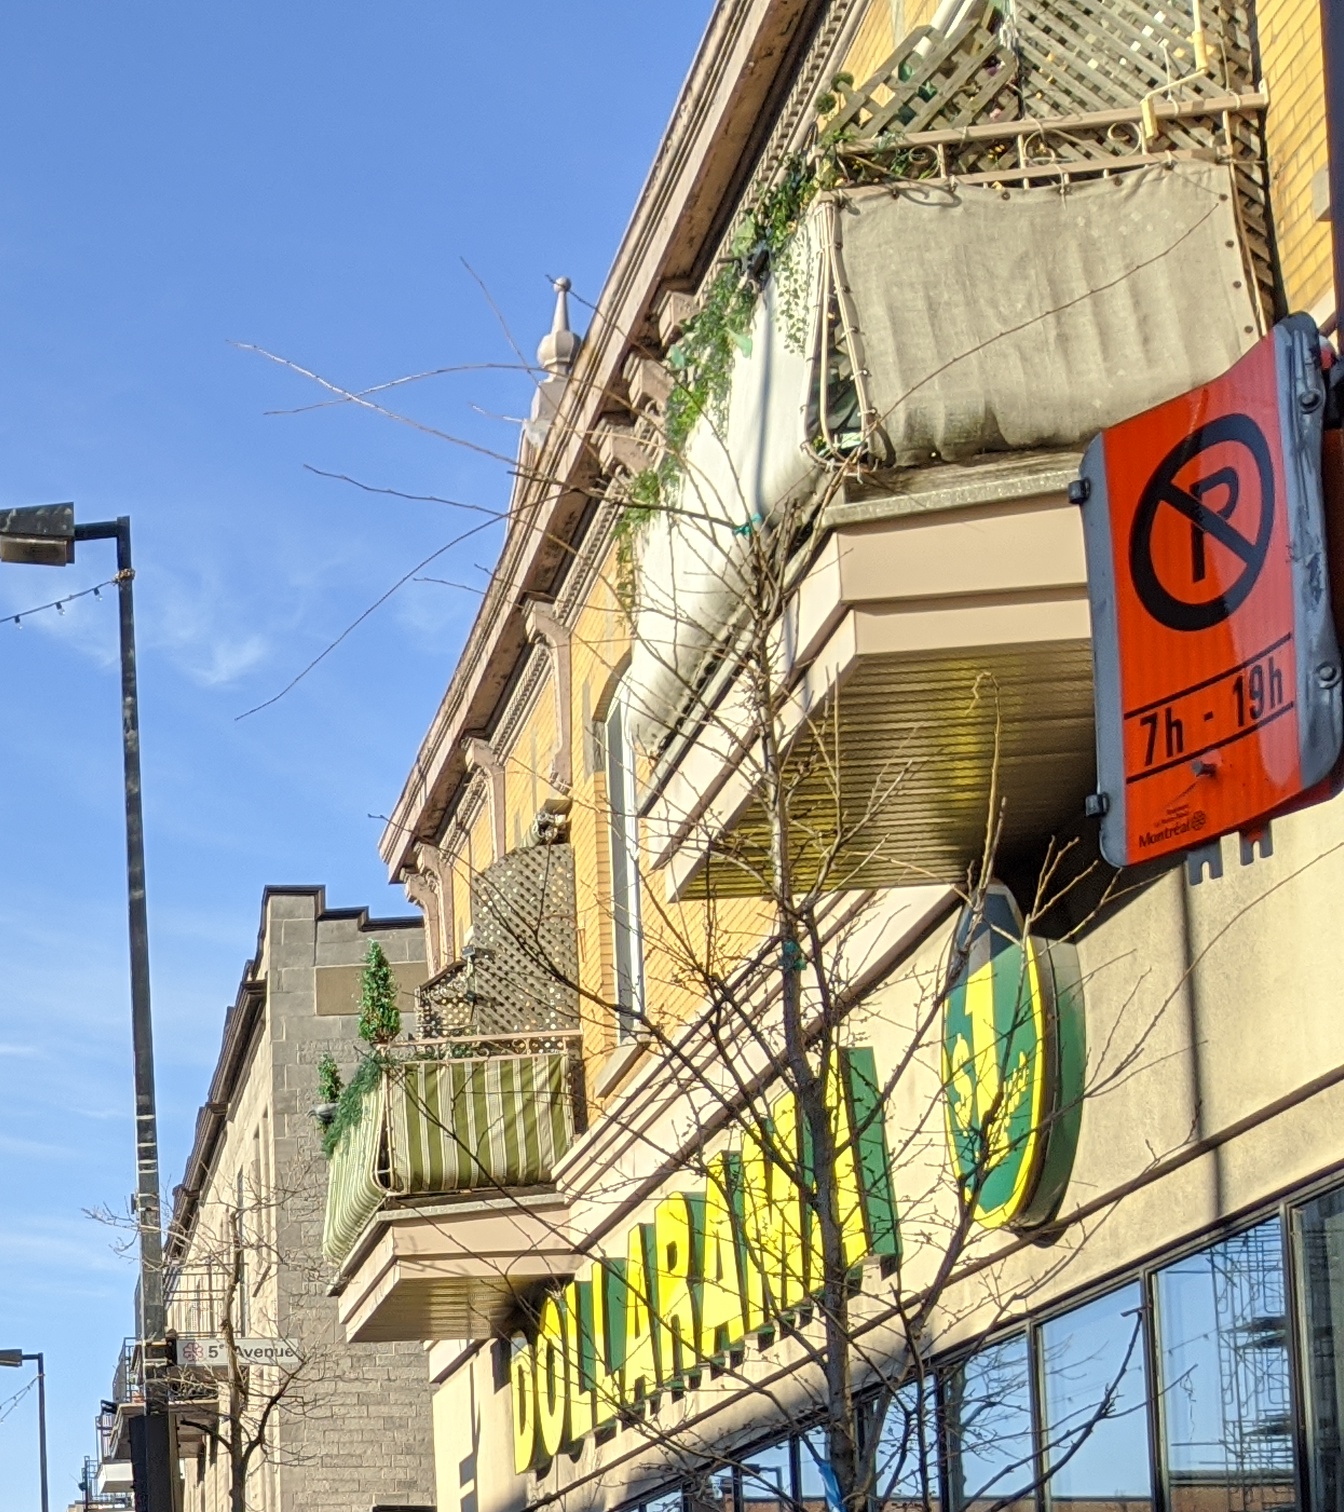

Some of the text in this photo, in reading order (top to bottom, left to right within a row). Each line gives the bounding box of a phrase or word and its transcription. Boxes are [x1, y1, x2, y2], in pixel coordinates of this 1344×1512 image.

[1139, 706, 1184, 767] 7h
[1232, 656, 1283, 728] 19h
[1138, 819, 1191, 849] Montréal
[511, 1045, 882, 1475] DOLLARAMA
[234, 1345, 294, 1359] Avenue
